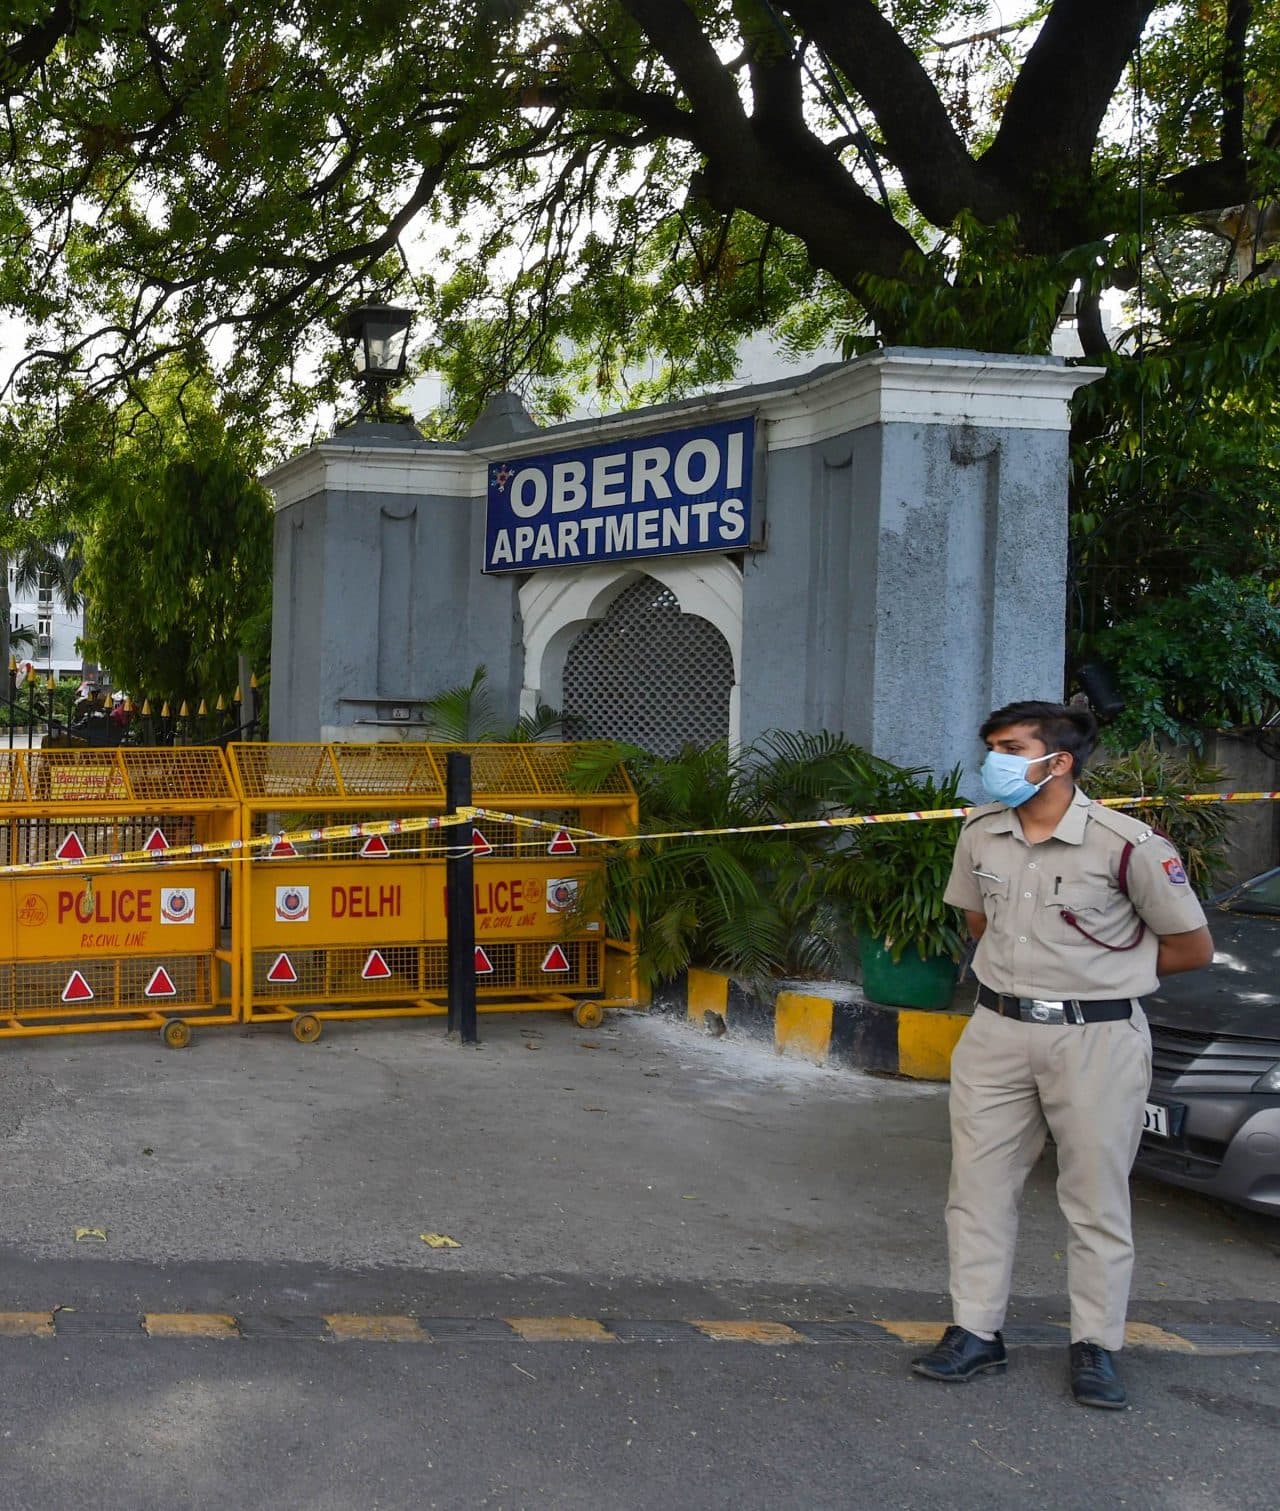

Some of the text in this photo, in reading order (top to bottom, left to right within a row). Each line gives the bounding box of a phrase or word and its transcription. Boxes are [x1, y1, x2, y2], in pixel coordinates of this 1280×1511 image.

[510, 432, 744, 518] OBEROI
[491, 498, 745, 565] APARTMENTS
[57, 889, 153, 925] POLICE
[331, 884, 401, 919] DELHI
[444, 879, 524, 918] LICE
